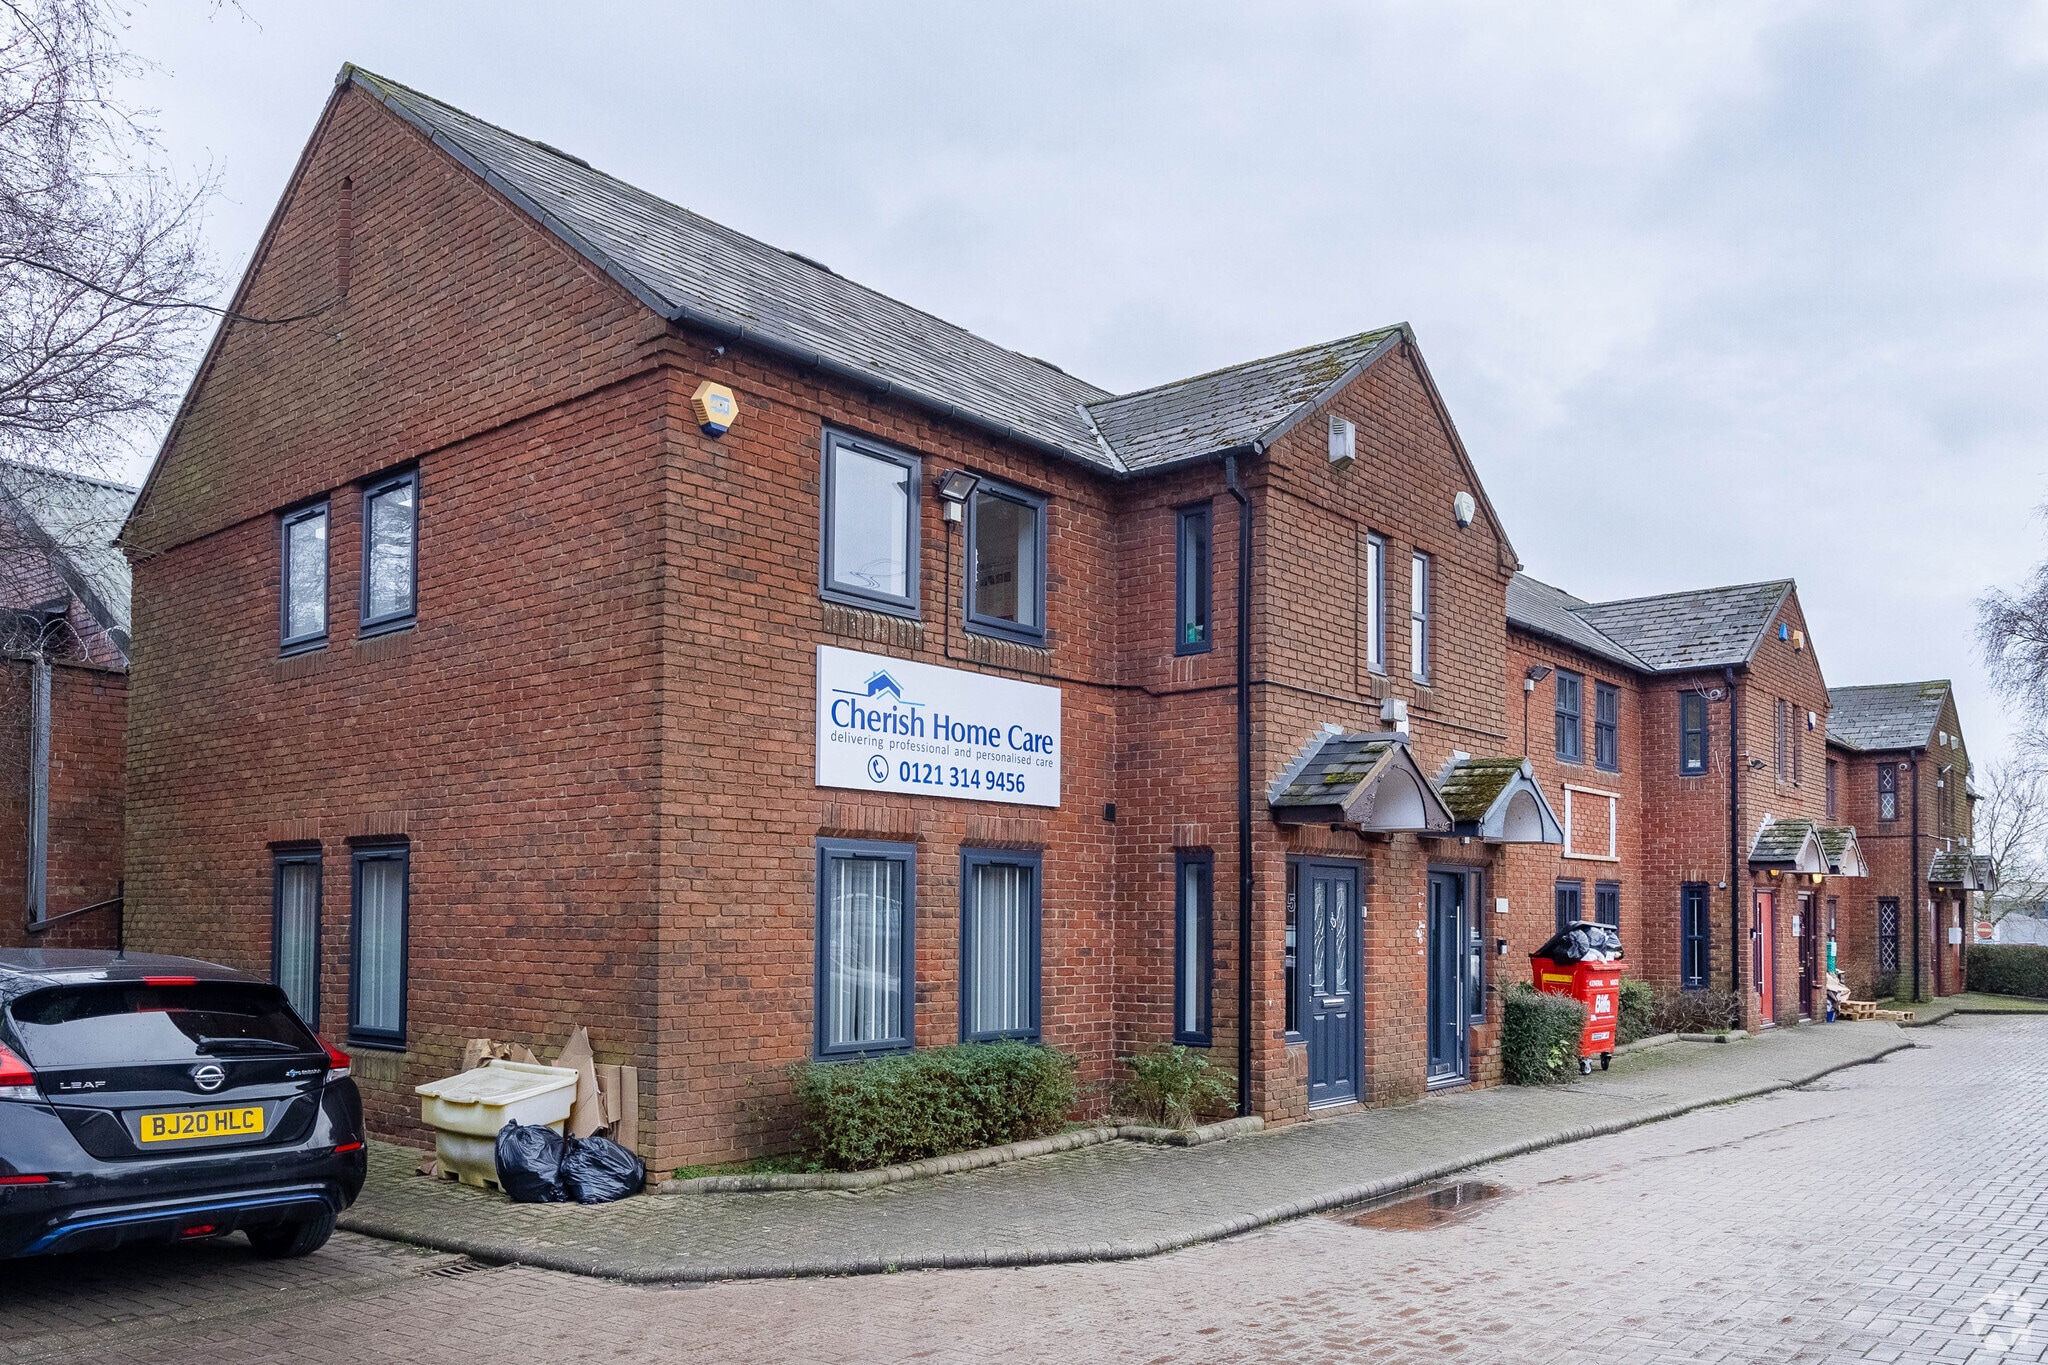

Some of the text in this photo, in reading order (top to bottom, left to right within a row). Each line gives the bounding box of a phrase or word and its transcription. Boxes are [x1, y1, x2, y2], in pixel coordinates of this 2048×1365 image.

[831, 699, 1054, 754] Cherish Home Care
[830, 730, 1054, 768] delivering professional and personalised care
[899, 761, 1026, 793] 0121 314 9456
[1287, 893, 1296, 912] 5
[59, 1080, 106, 1090] LEAF
[152, 1110, 254, 1136] BJ20 HLC
